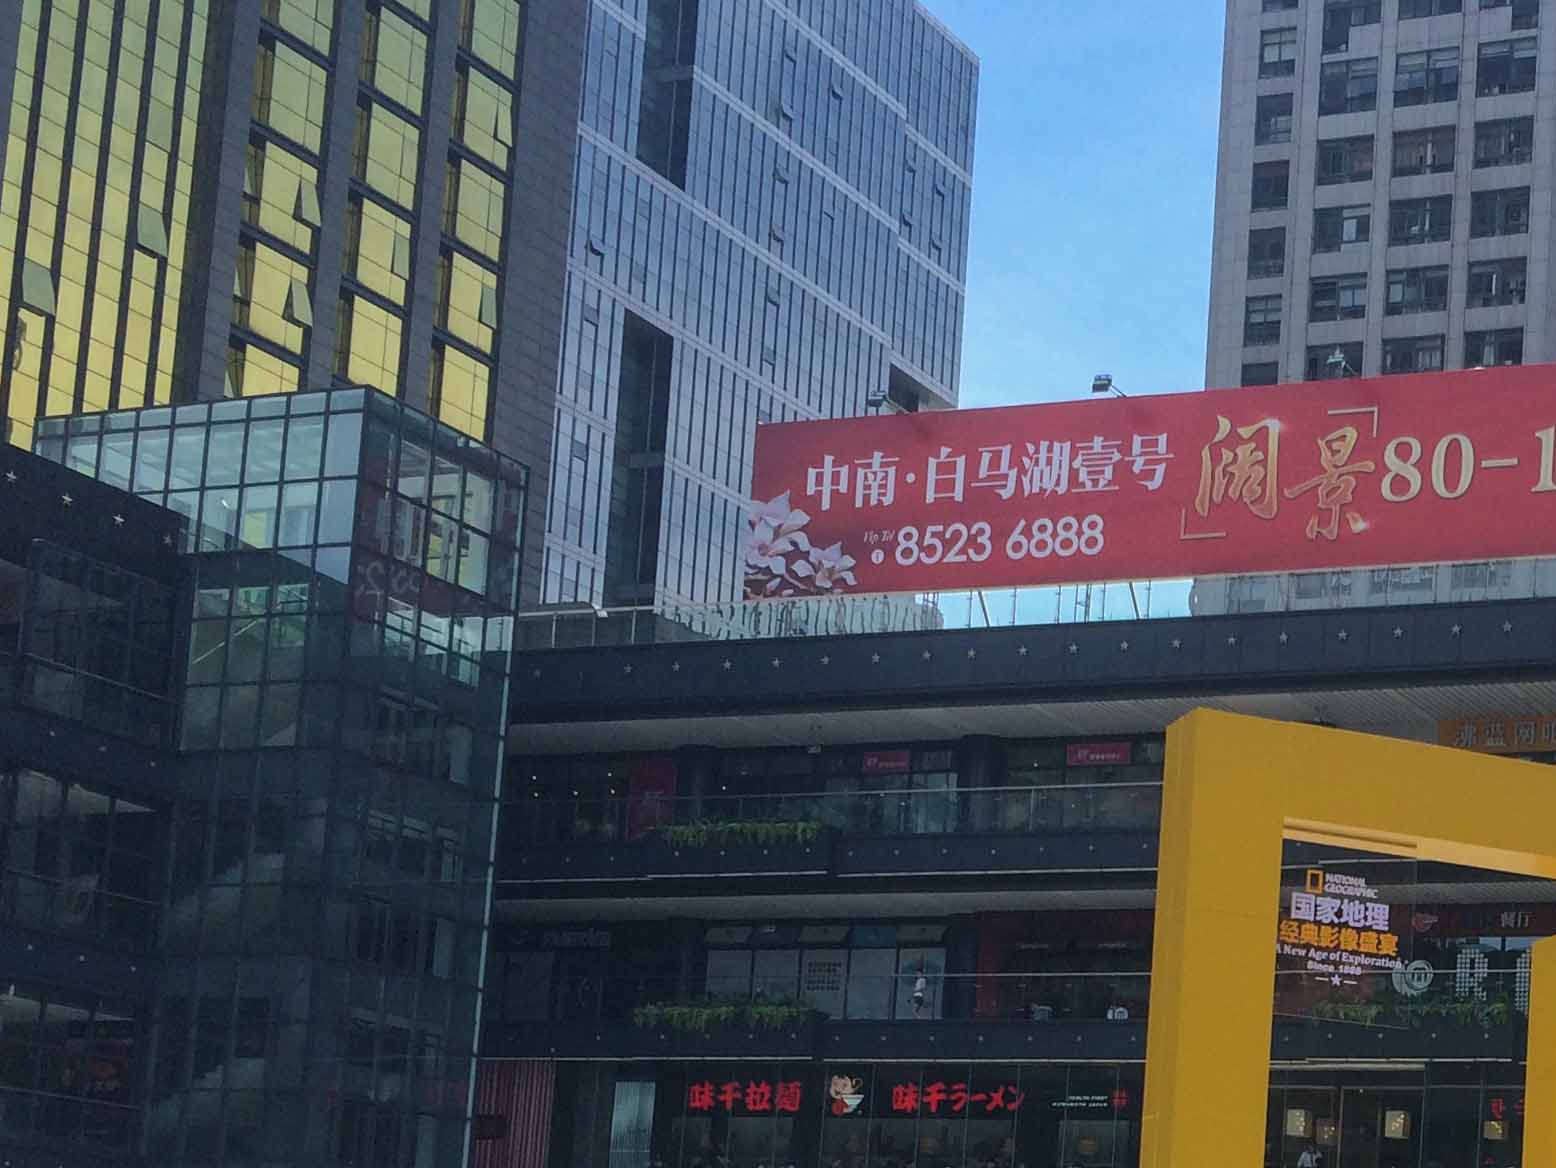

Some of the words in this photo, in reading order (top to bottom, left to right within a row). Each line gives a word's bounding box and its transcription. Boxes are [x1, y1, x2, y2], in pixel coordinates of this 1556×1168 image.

[806, 432, 1174, 511] 中南·白马湖壹号
[896, 521, 993, 566] 8523
[1006, 514, 1104, 560] 6888
[1291, 892, 1389, 931] 国家地理
[1284, 944, 1306, 955] New
[1308, 948, 1329, 960] Age
[1329, 952, 1341, 960] of
